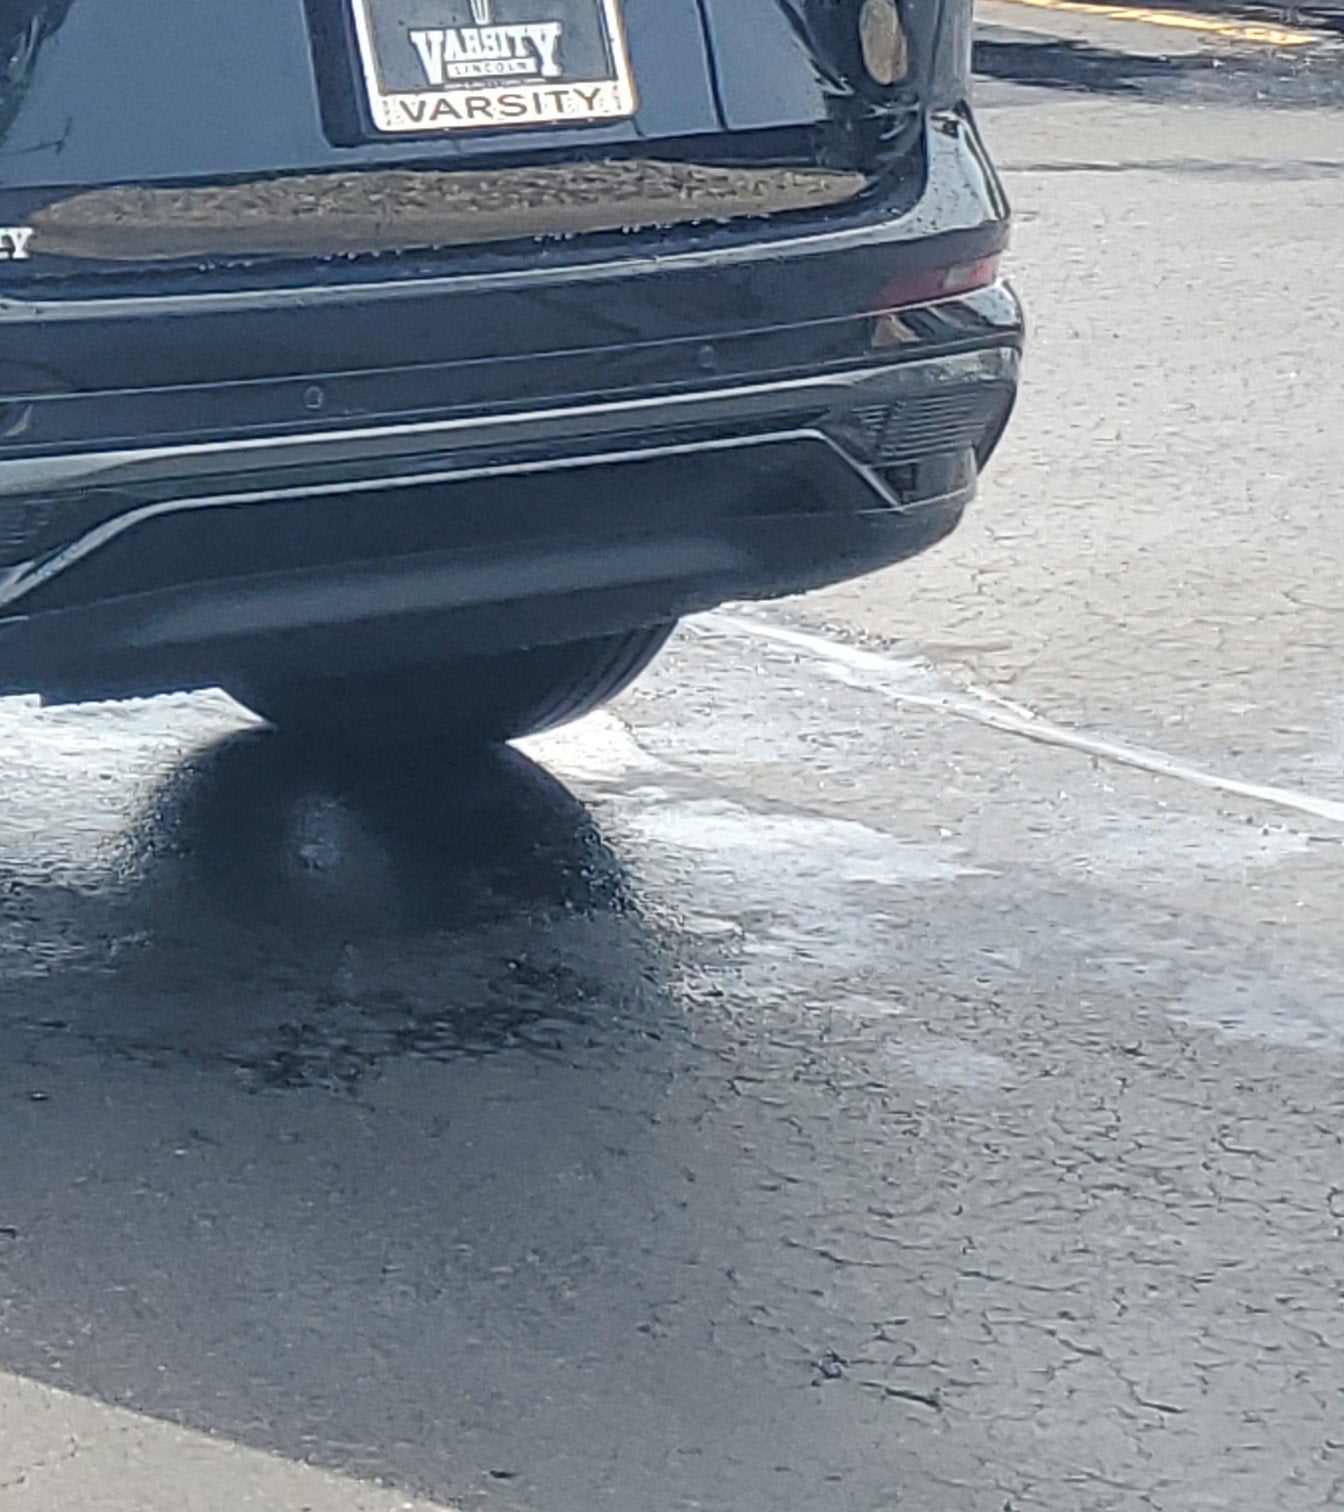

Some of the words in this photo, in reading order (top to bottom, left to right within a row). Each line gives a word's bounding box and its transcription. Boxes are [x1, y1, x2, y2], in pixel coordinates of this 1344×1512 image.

[410, 21, 562, 86] VARSITY
[454, 61, 527, 76] LINCOLN
[399, 87, 602, 123] VARSITY
